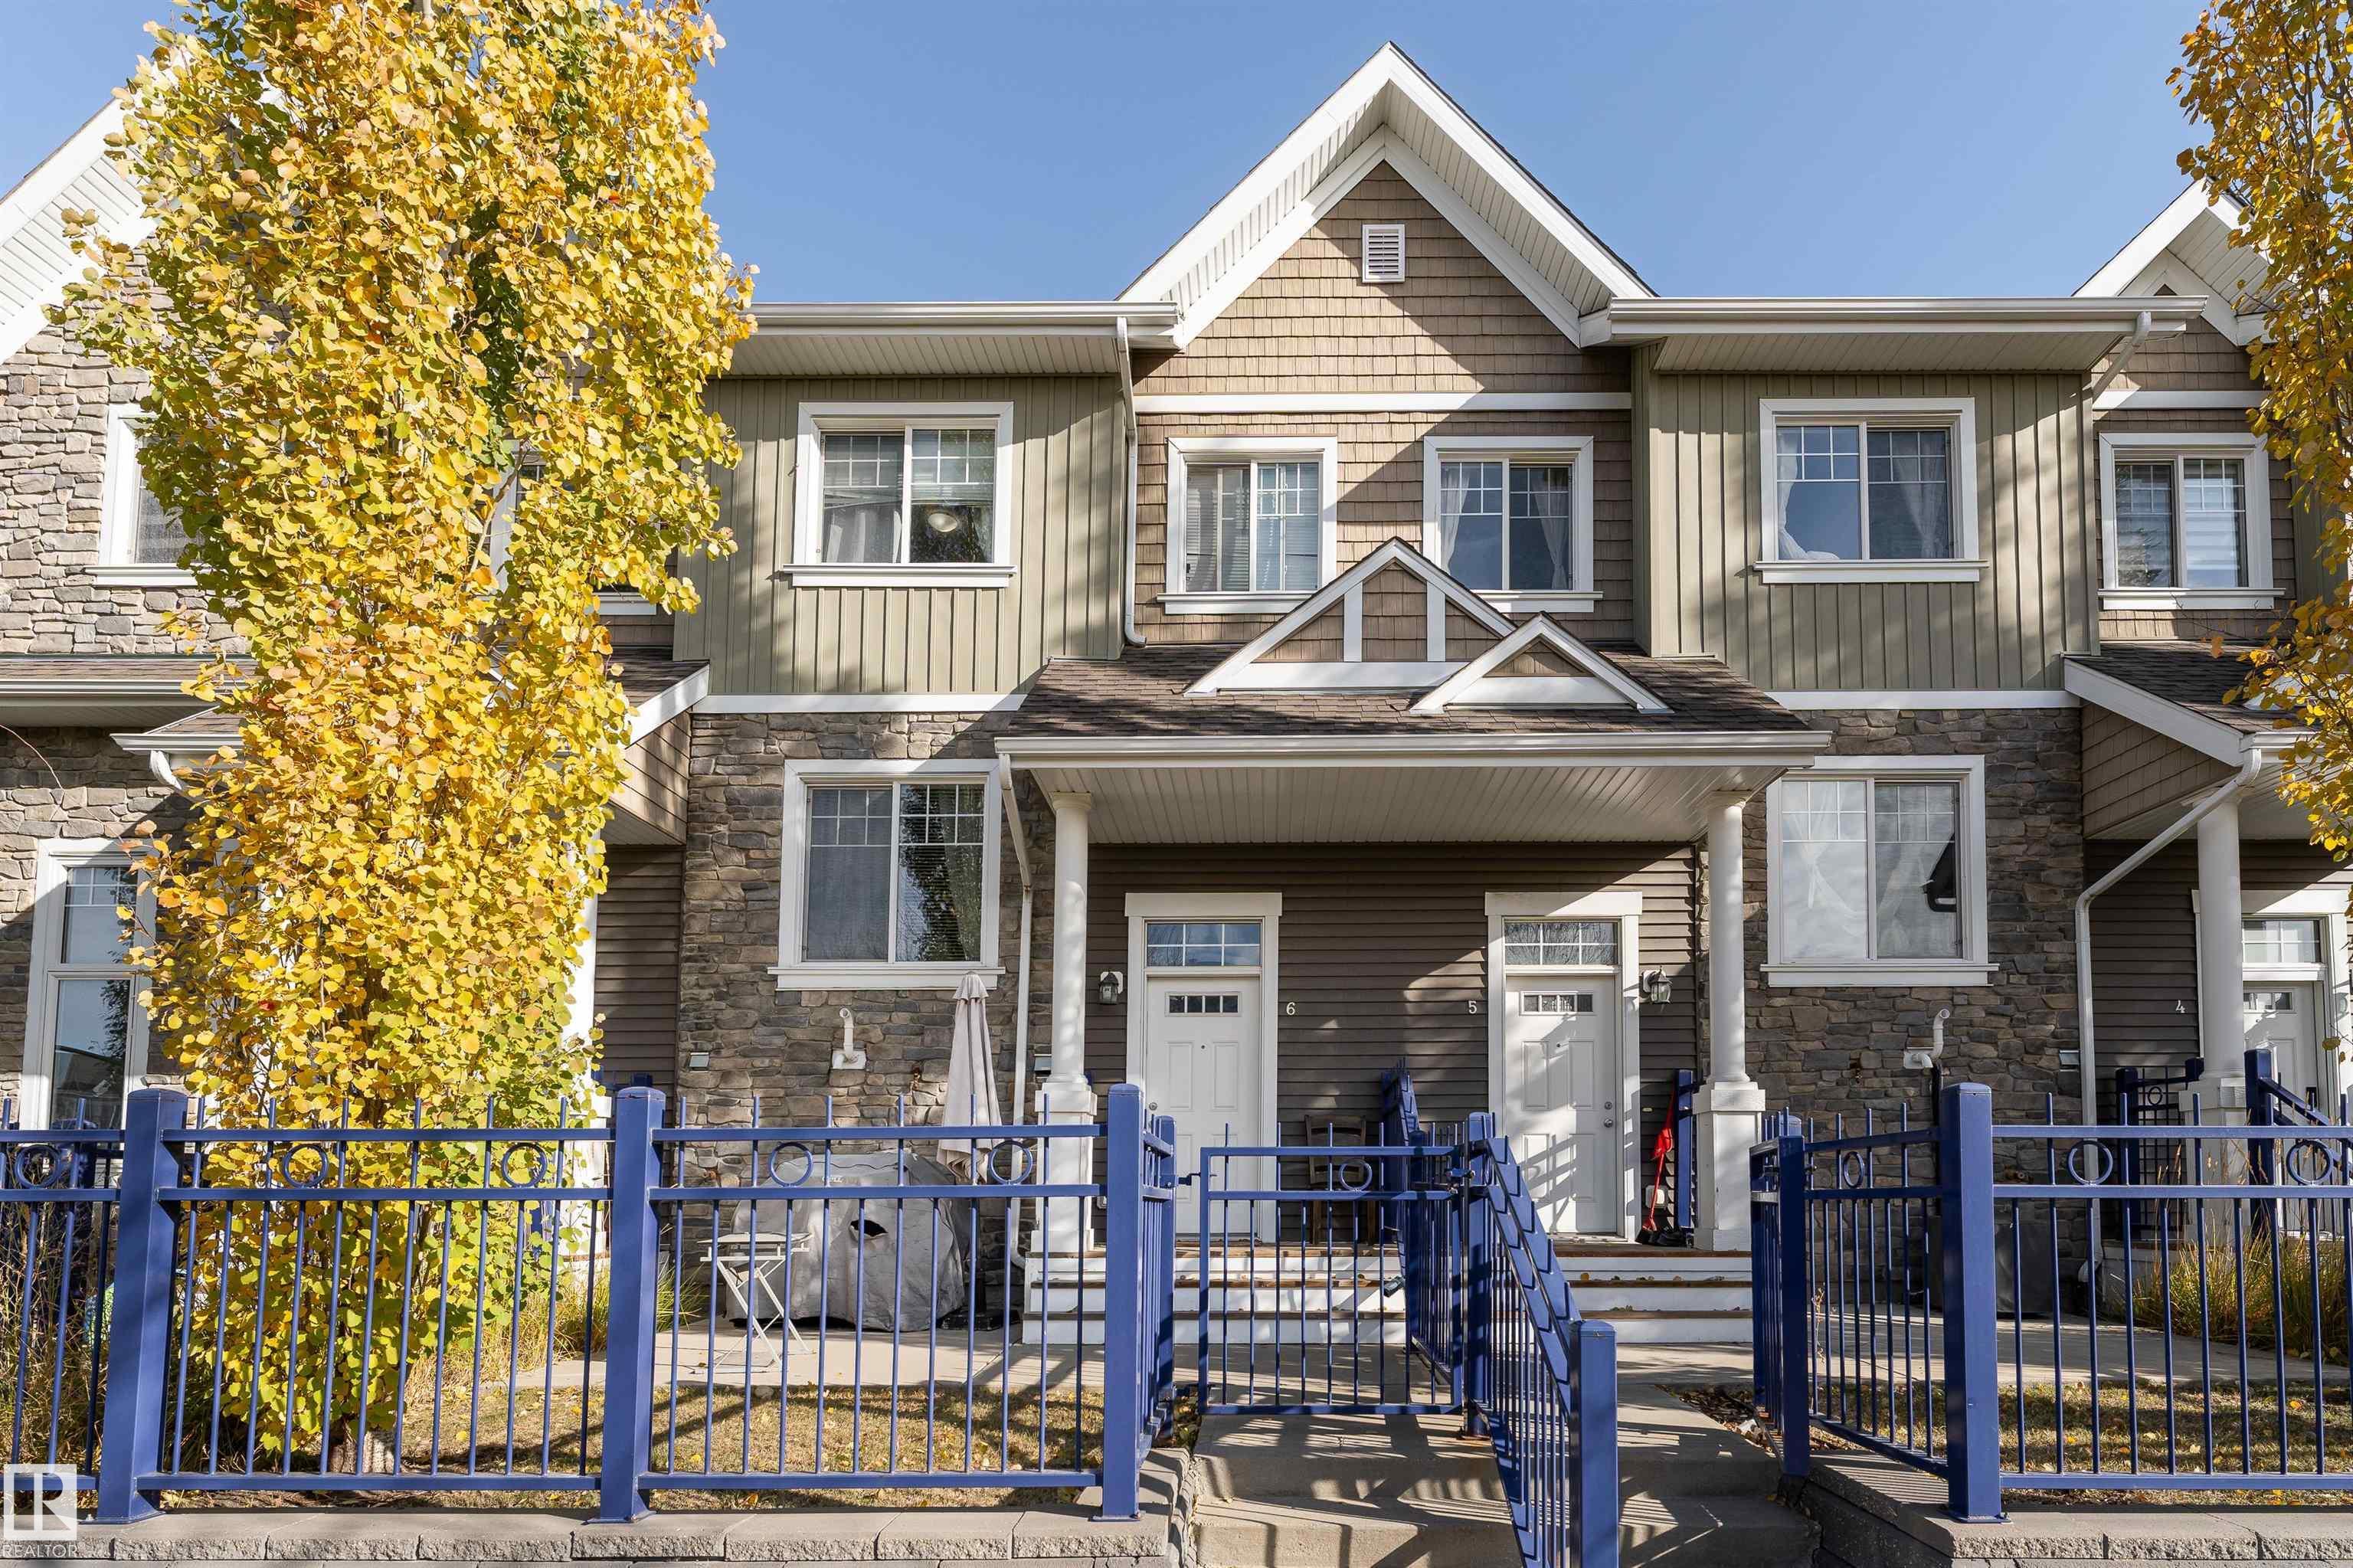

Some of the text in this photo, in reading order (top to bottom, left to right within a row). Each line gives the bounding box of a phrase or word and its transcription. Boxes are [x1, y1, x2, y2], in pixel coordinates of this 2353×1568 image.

[1287, 1002, 1295, 1015] 6
[1468, 1000, 1477, 1013] 5
[2175, 1000, 2185, 1013] 4
